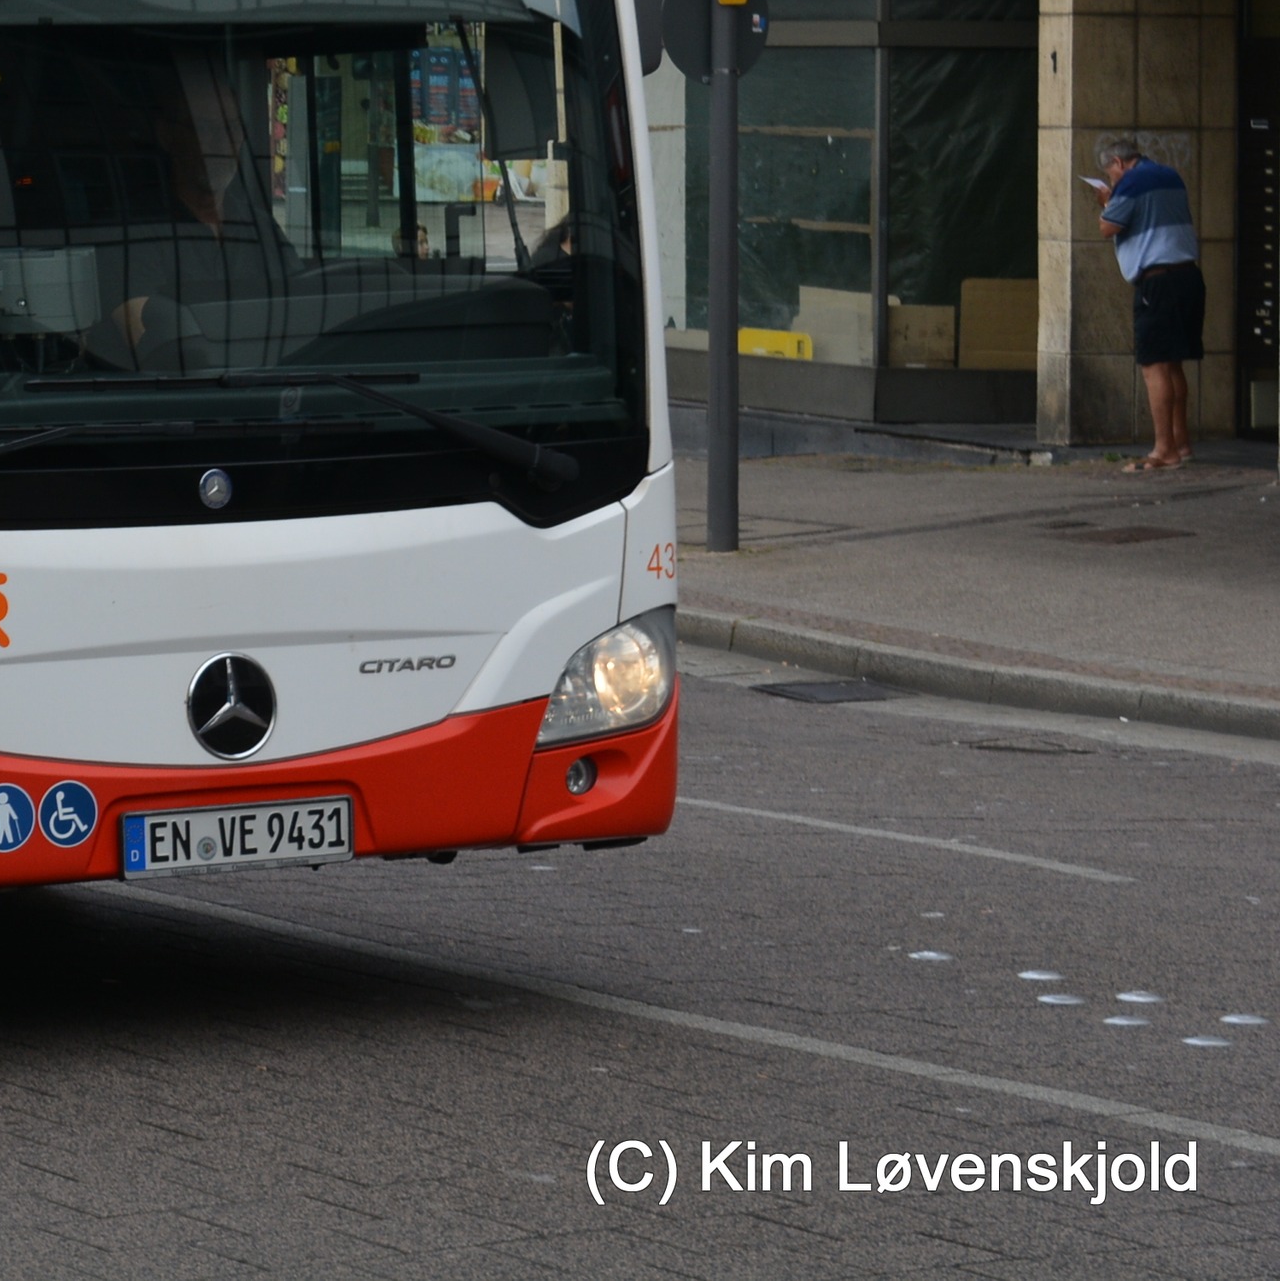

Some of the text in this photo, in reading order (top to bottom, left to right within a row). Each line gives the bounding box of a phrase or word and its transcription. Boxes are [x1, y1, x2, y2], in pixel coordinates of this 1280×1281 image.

[359, 655, 456, 674] CITARO
[149, 807, 345, 863] EN VE 9431
[130, 849, 140, 862] D
